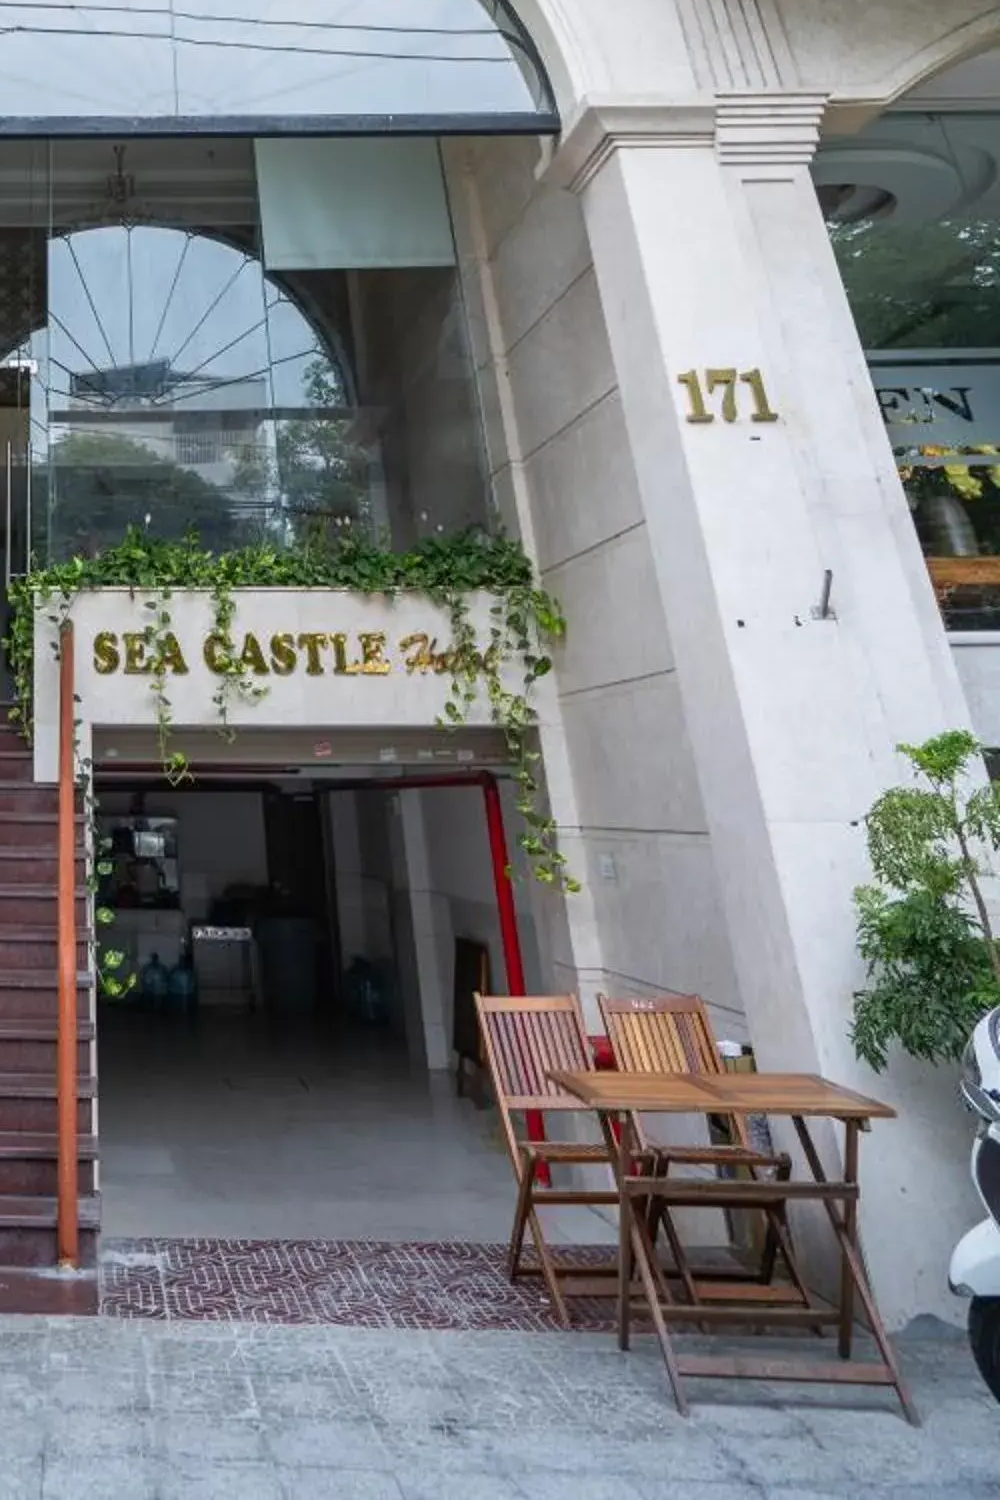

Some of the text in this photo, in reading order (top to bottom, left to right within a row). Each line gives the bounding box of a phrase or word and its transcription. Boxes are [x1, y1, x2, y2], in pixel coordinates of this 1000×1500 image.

[677, 367, 779, 423] 171
[93, 630, 189, 675] SEA
[203, 630, 390, 675] CASTLE
